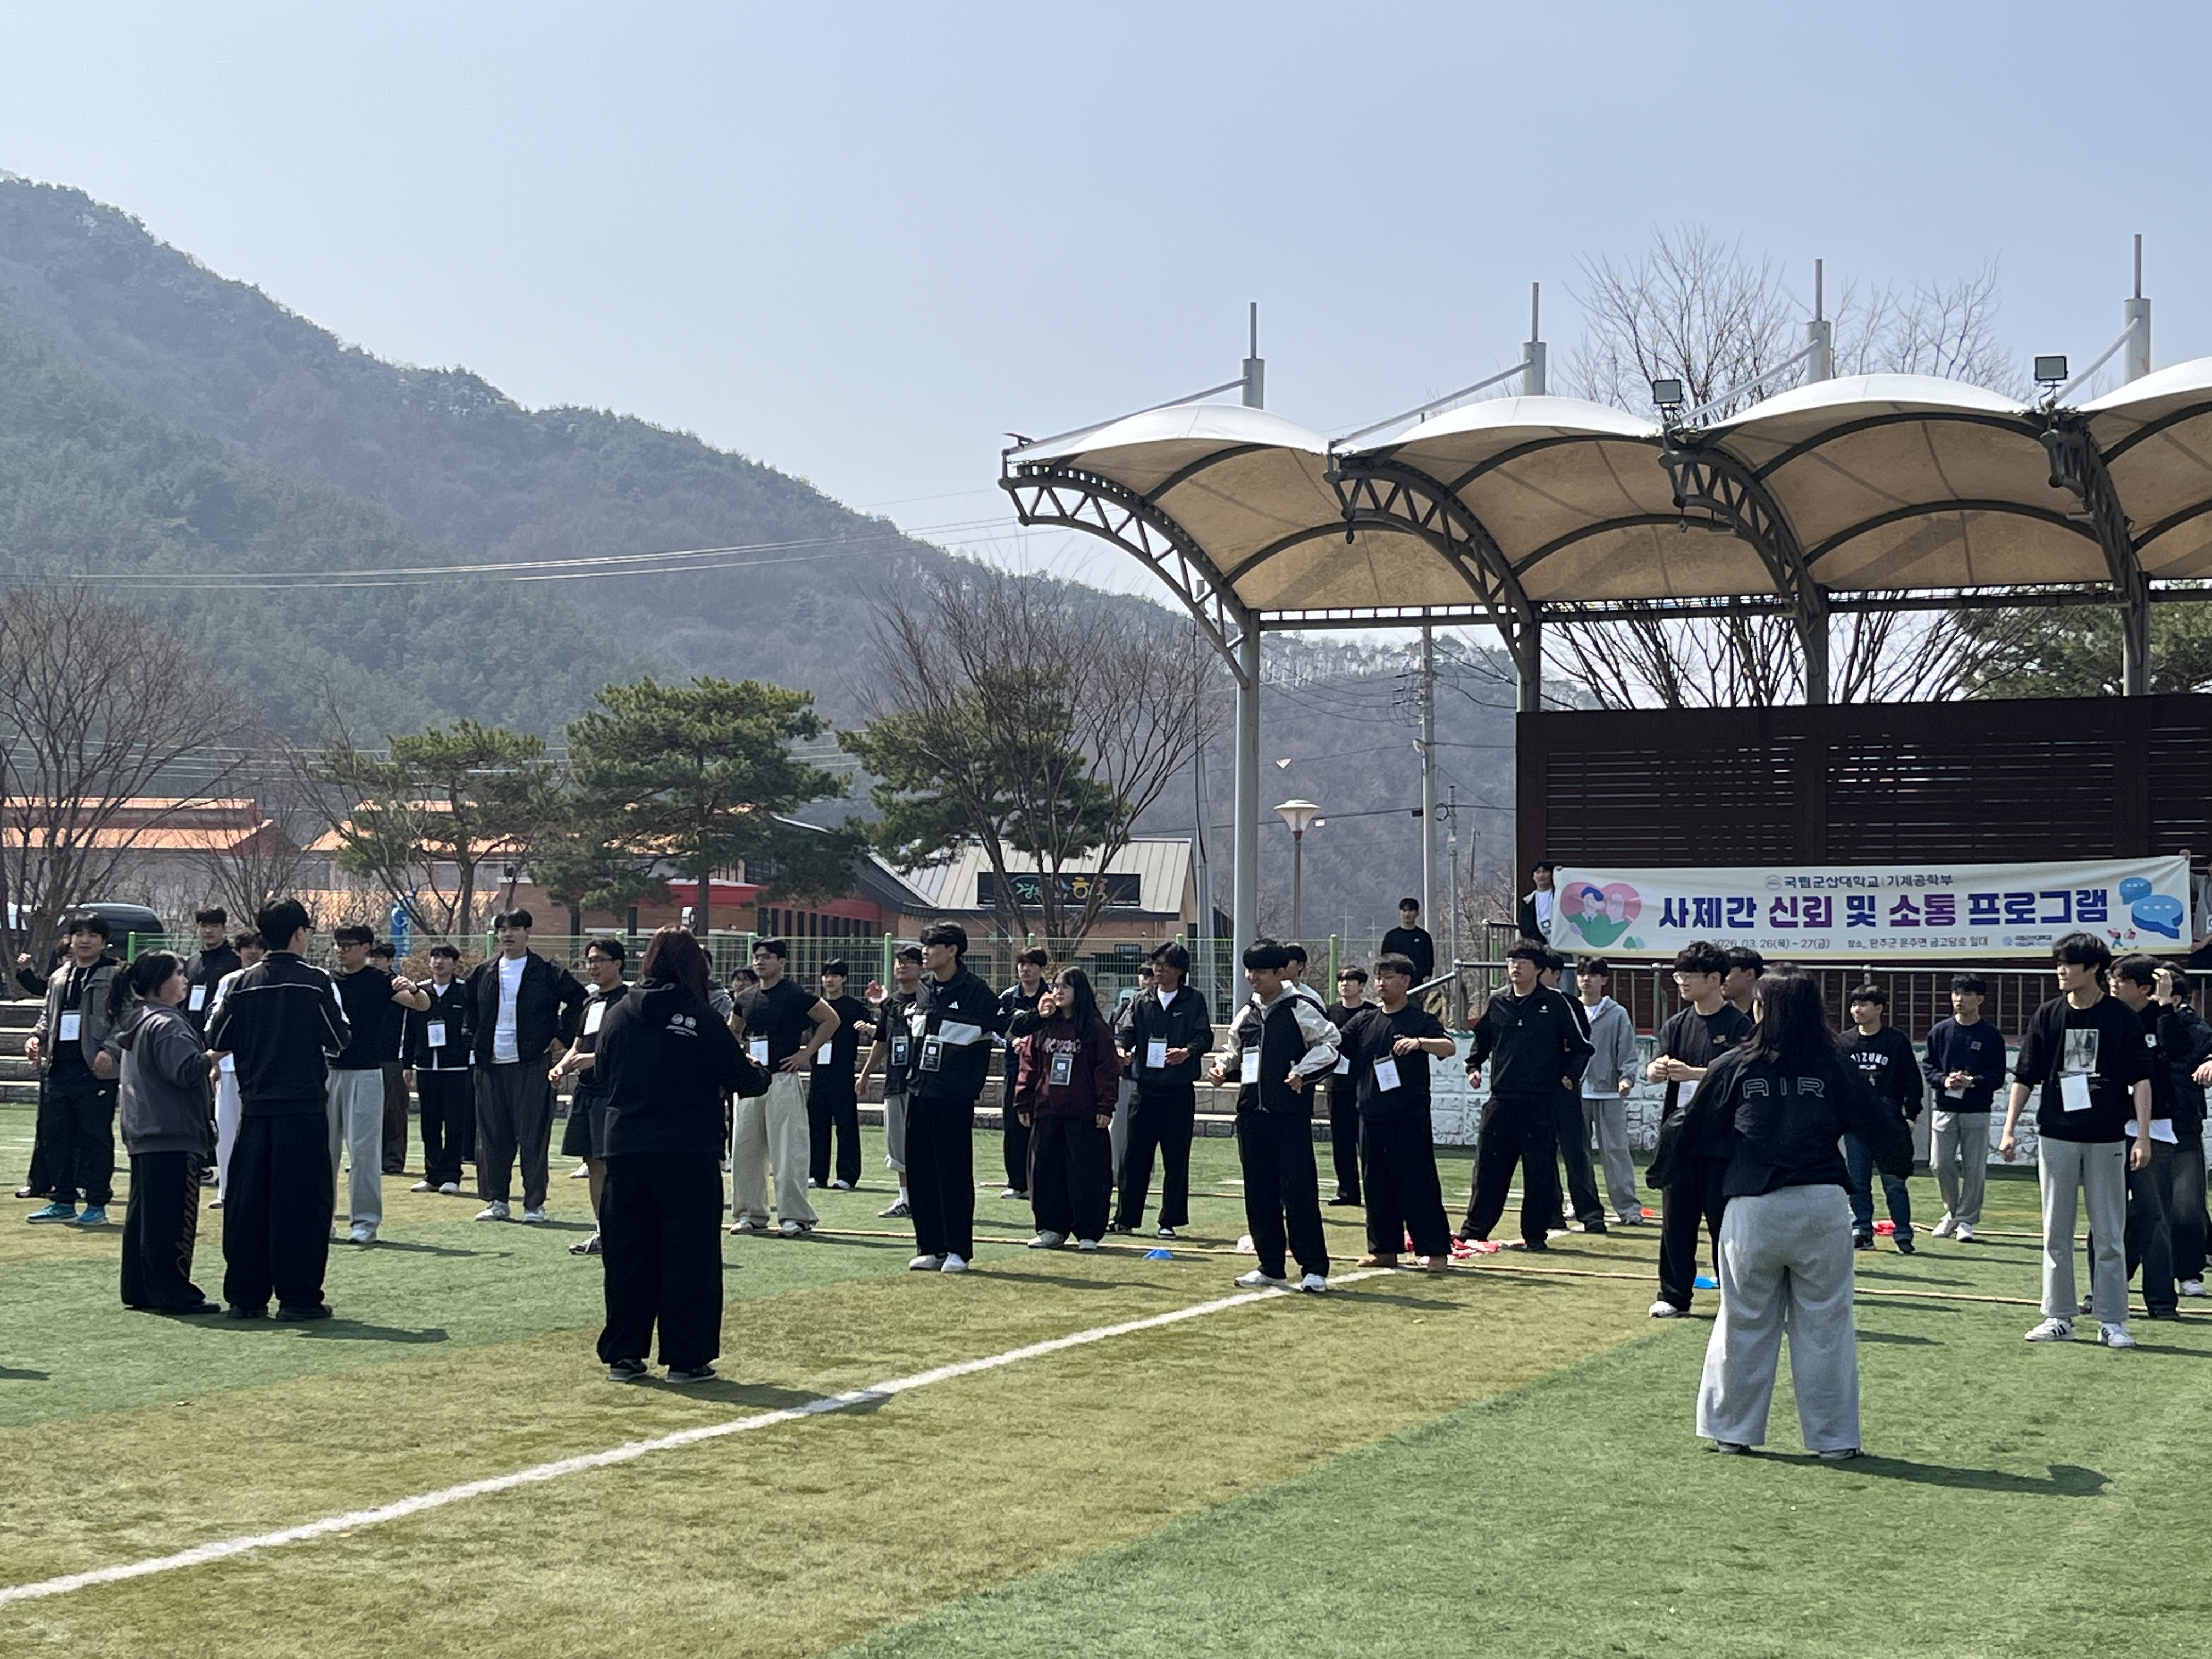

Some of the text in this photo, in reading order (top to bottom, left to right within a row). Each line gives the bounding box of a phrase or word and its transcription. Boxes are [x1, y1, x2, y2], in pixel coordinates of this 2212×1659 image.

[1784, 874, 1954, 888] 국립군산대학교 기계공학부
[1659, 889, 2107, 928] 사제간 신뢰 및 소통 프로그램
[1742, 1077, 1825, 1099] AIR
